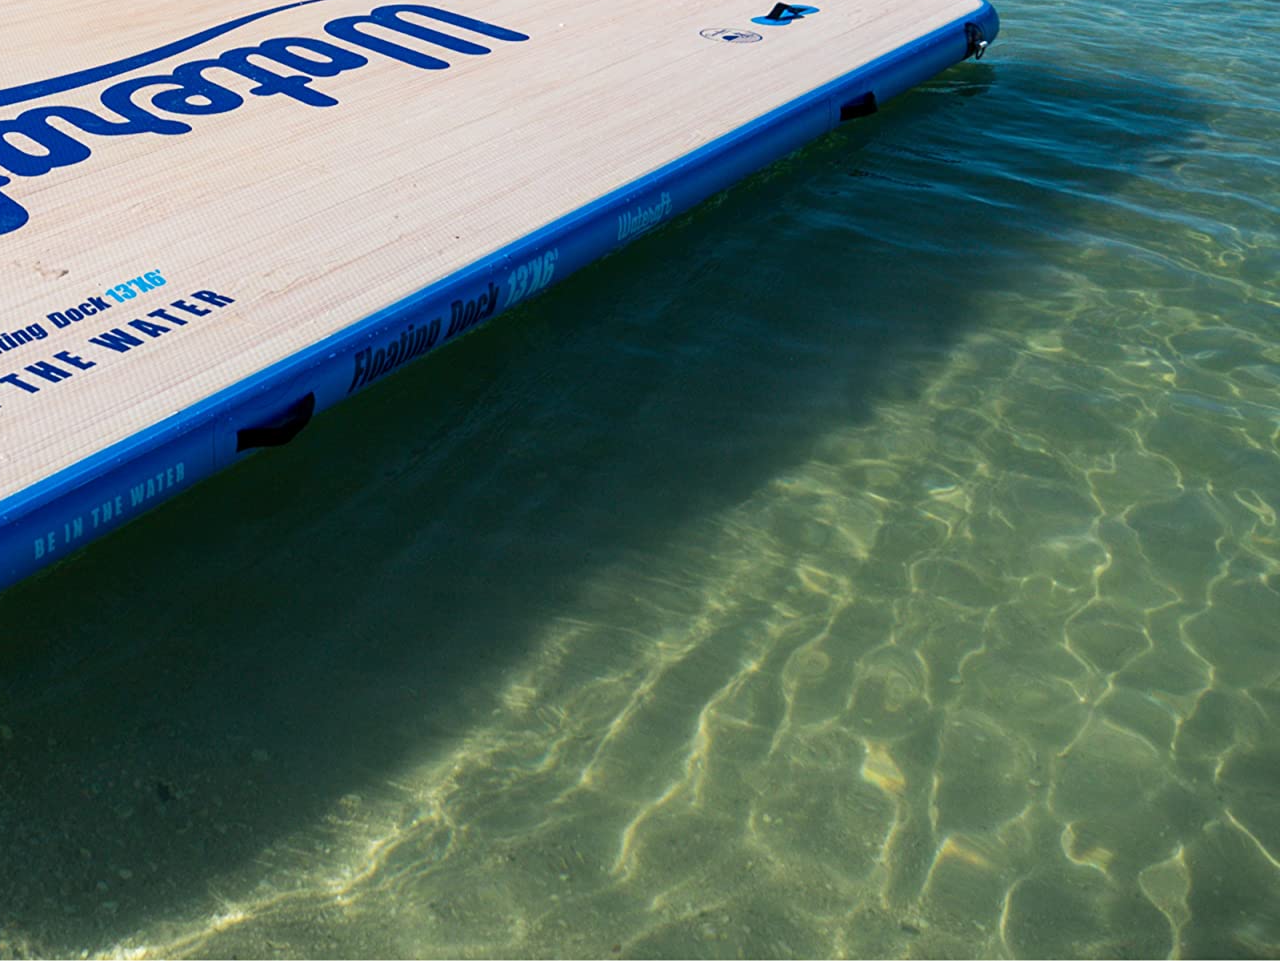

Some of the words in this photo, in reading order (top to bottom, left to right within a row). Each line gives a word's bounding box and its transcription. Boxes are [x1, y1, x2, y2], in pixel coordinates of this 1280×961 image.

[46, 294, 112, 330] Dock
[88, 289, 236, 353] WATER
[34, 531, 56, 560] BE
[64, 516, 83, 543] IN
[91, 495, 122, 528] THE
[130, 462, 185, 507] WATER
